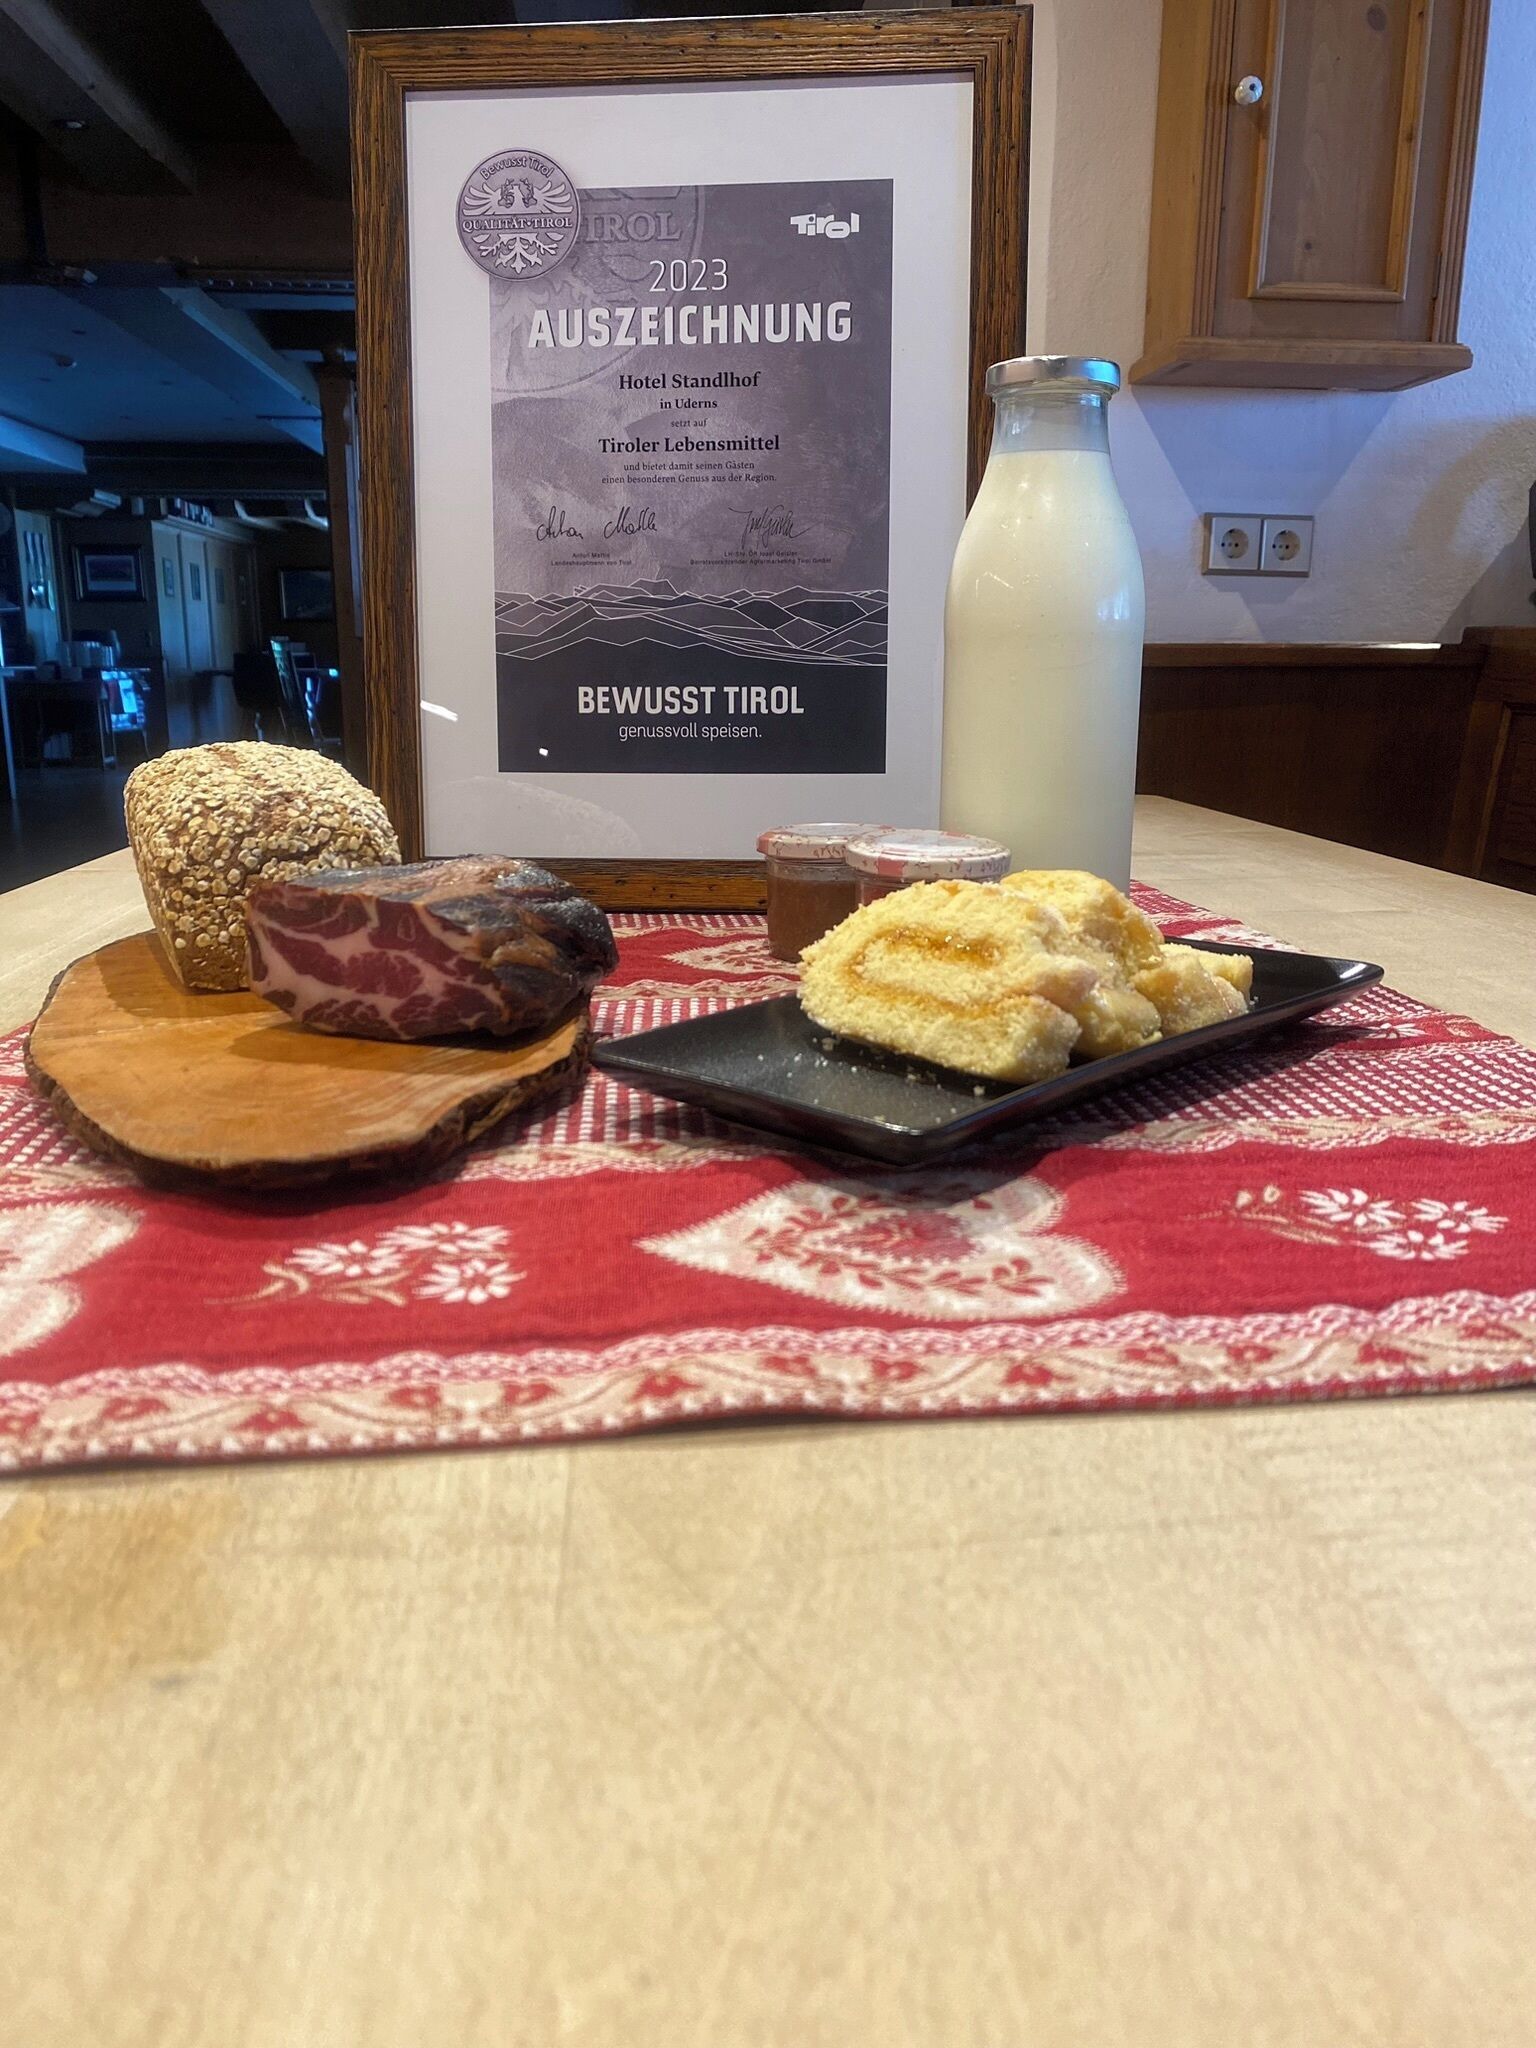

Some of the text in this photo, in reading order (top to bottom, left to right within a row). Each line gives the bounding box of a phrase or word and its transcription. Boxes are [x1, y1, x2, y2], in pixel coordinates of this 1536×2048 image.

[480, 155, 555, 180] Bewusst Tirol
[579, 211, 682, 243] IROL
[790, 212, 860, 239] Tirol
[649, 258, 728, 292] 2023
[528, 301, 852, 348] AUSZEICHNUNG
[619, 371, 761, 389] Hotel Standlhof
[660, 397, 718, 410] in Uderns
[671, 418, 708, 428] setzt auf
[599, 434, 780, 453] Tiroler Lebensmittel
[624, 460, 755, 471] und bietet damit seinen Gästen
[602, 473, 777, 484] einen besonderen Genuss aus der Region.
[578, 684, 805, 715] BEWUSST TIROL
[619, 722, 762, 741] genussvoll speisen.
